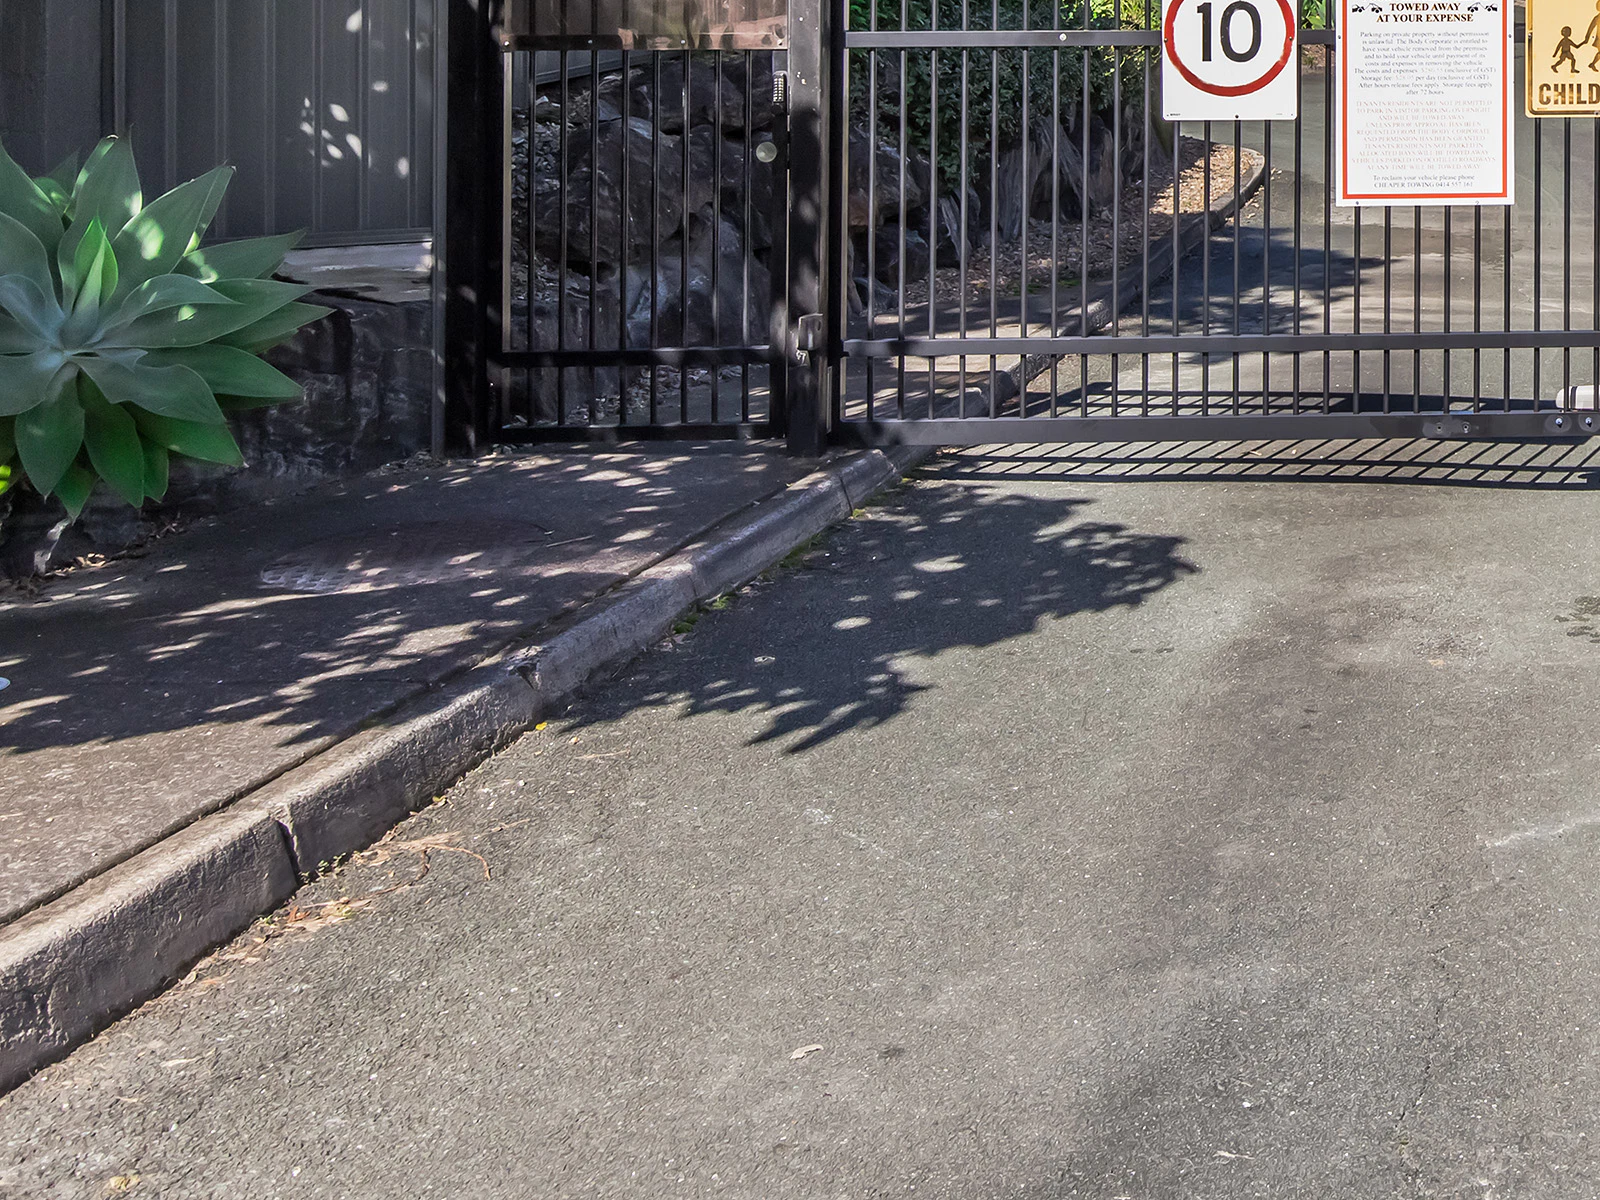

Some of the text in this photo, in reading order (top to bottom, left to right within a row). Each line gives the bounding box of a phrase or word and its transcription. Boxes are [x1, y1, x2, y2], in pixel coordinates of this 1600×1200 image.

[1389, 2, 1461, 11] TOWED AWAY
[1376, 14, 1474, 23] AT YOUR EXPENSE
[1196, 0, 1262, 63] 10
